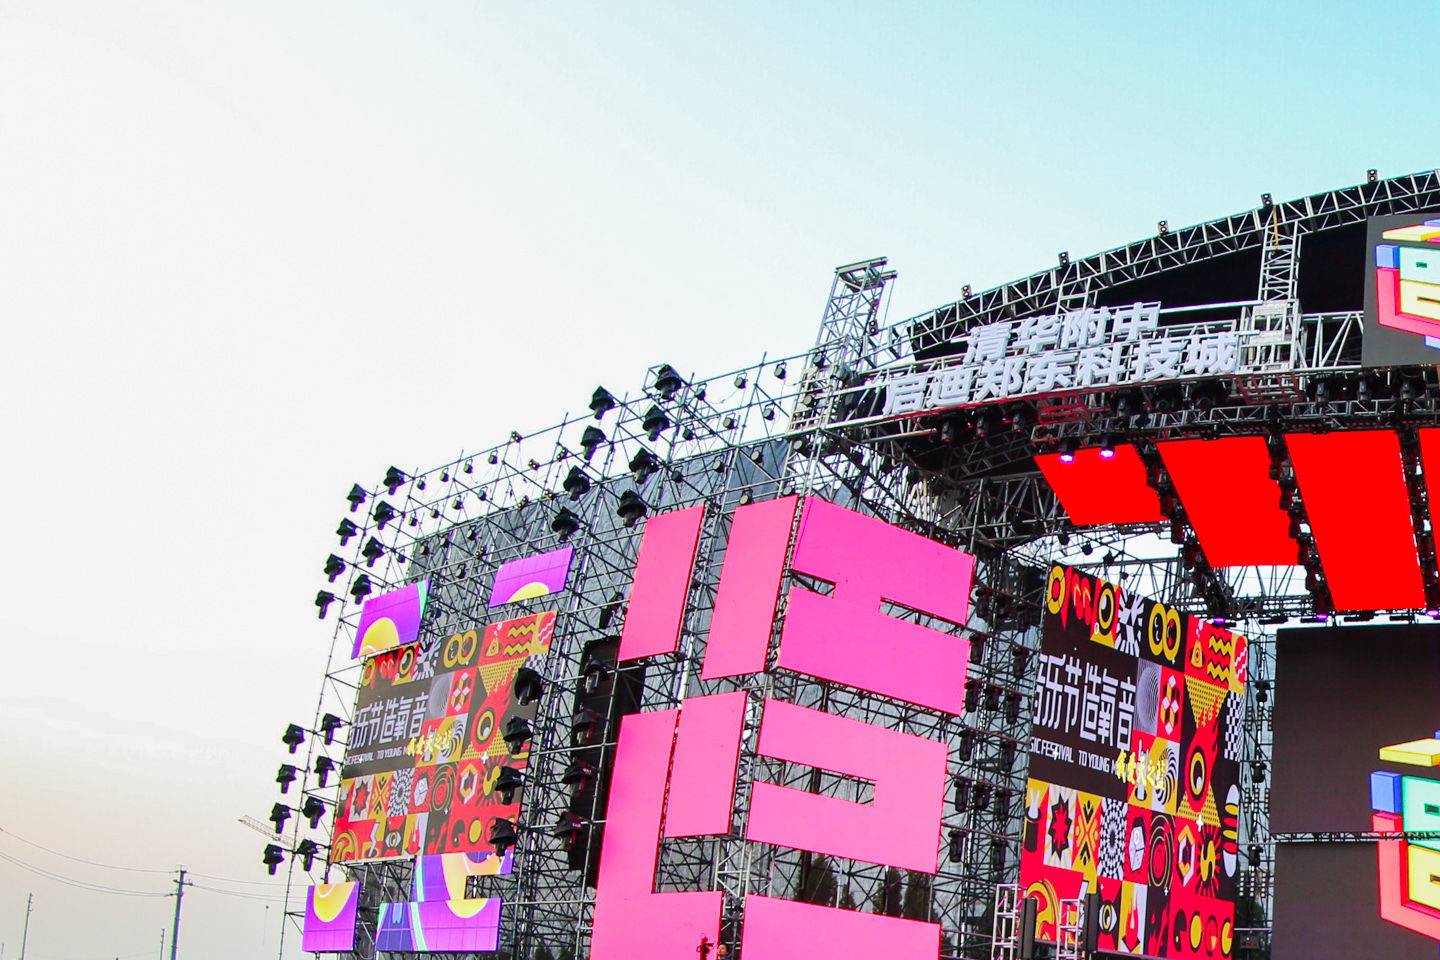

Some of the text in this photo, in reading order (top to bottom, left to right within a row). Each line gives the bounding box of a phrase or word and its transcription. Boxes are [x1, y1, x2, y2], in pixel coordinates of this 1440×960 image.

[963, 302, 1162, 365] 清华附中
[883, 331, 1239, 416] 启迪郑东科技城
